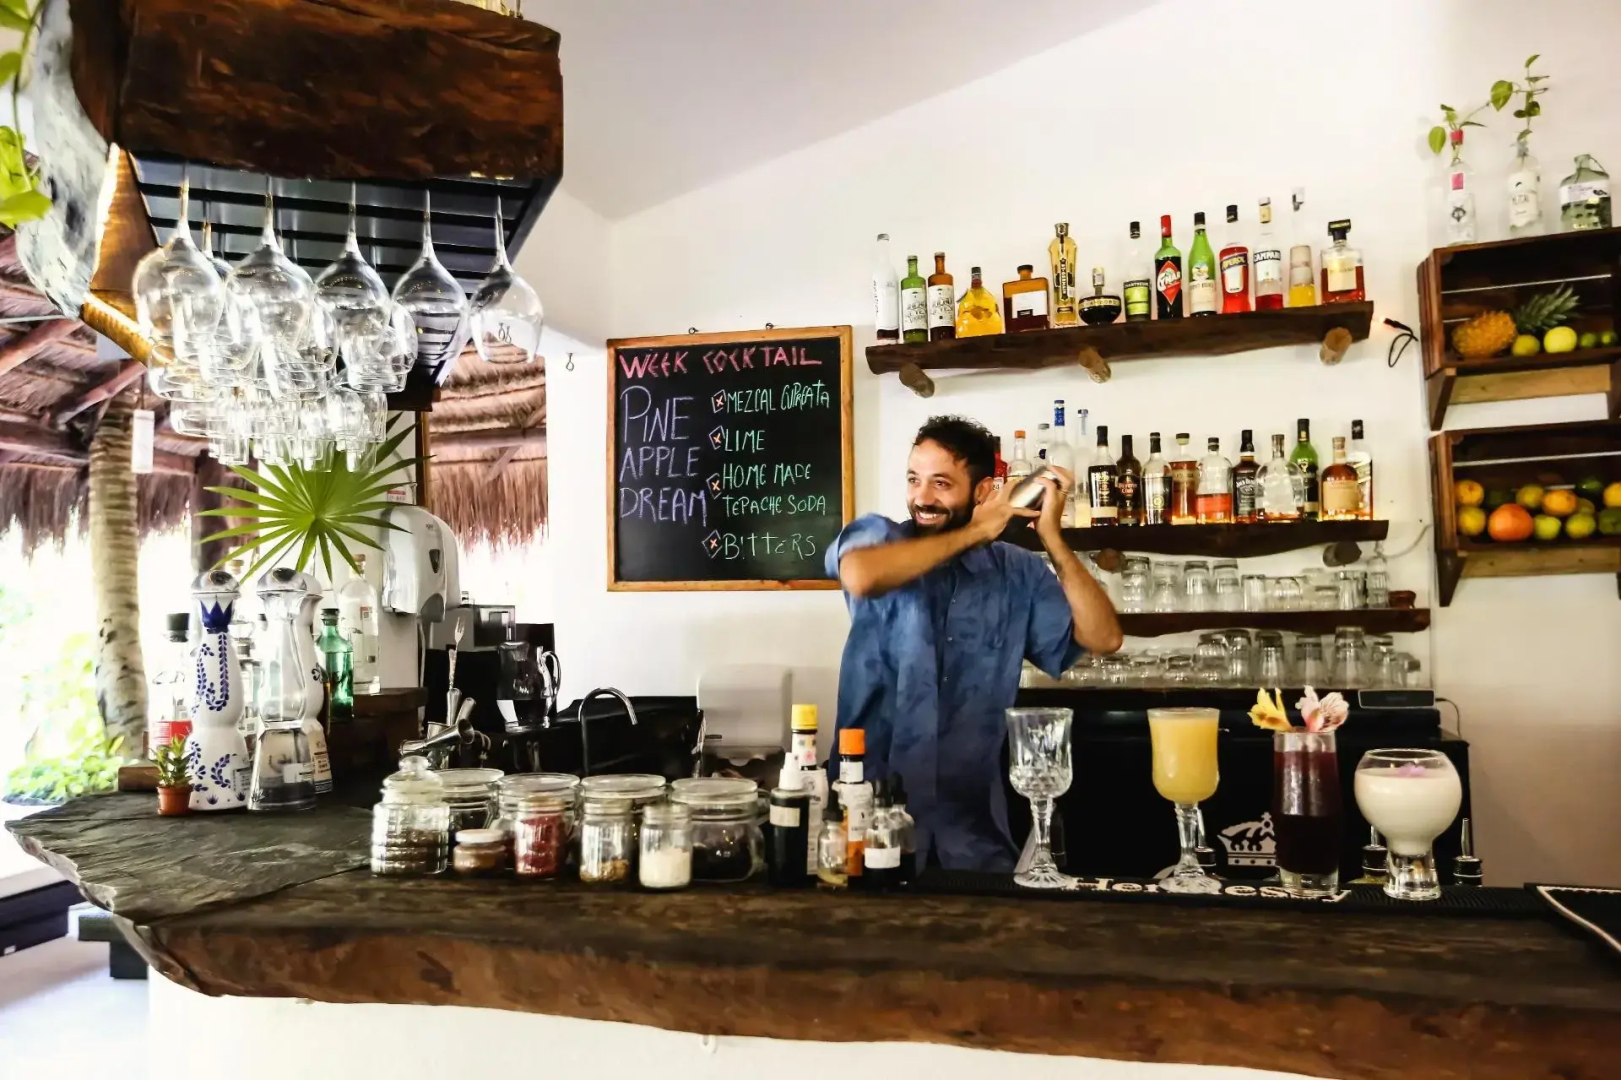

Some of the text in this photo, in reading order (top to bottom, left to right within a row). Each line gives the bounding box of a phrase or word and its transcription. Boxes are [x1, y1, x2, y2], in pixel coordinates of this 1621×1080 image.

[619, 346, 822, 379] WEEK COCKTAIL
[620, 385, 695, 443] PINE
[726, 389, 776, 415] MEZCAL
[725, 428, 765, 453] LIME
[619, 446, 700, 482] APPLE
[723, 463, 812, 489] HOME MADE
[619, 487, 707, 527] DREAM
[787, 494, 826, 516] SODA
